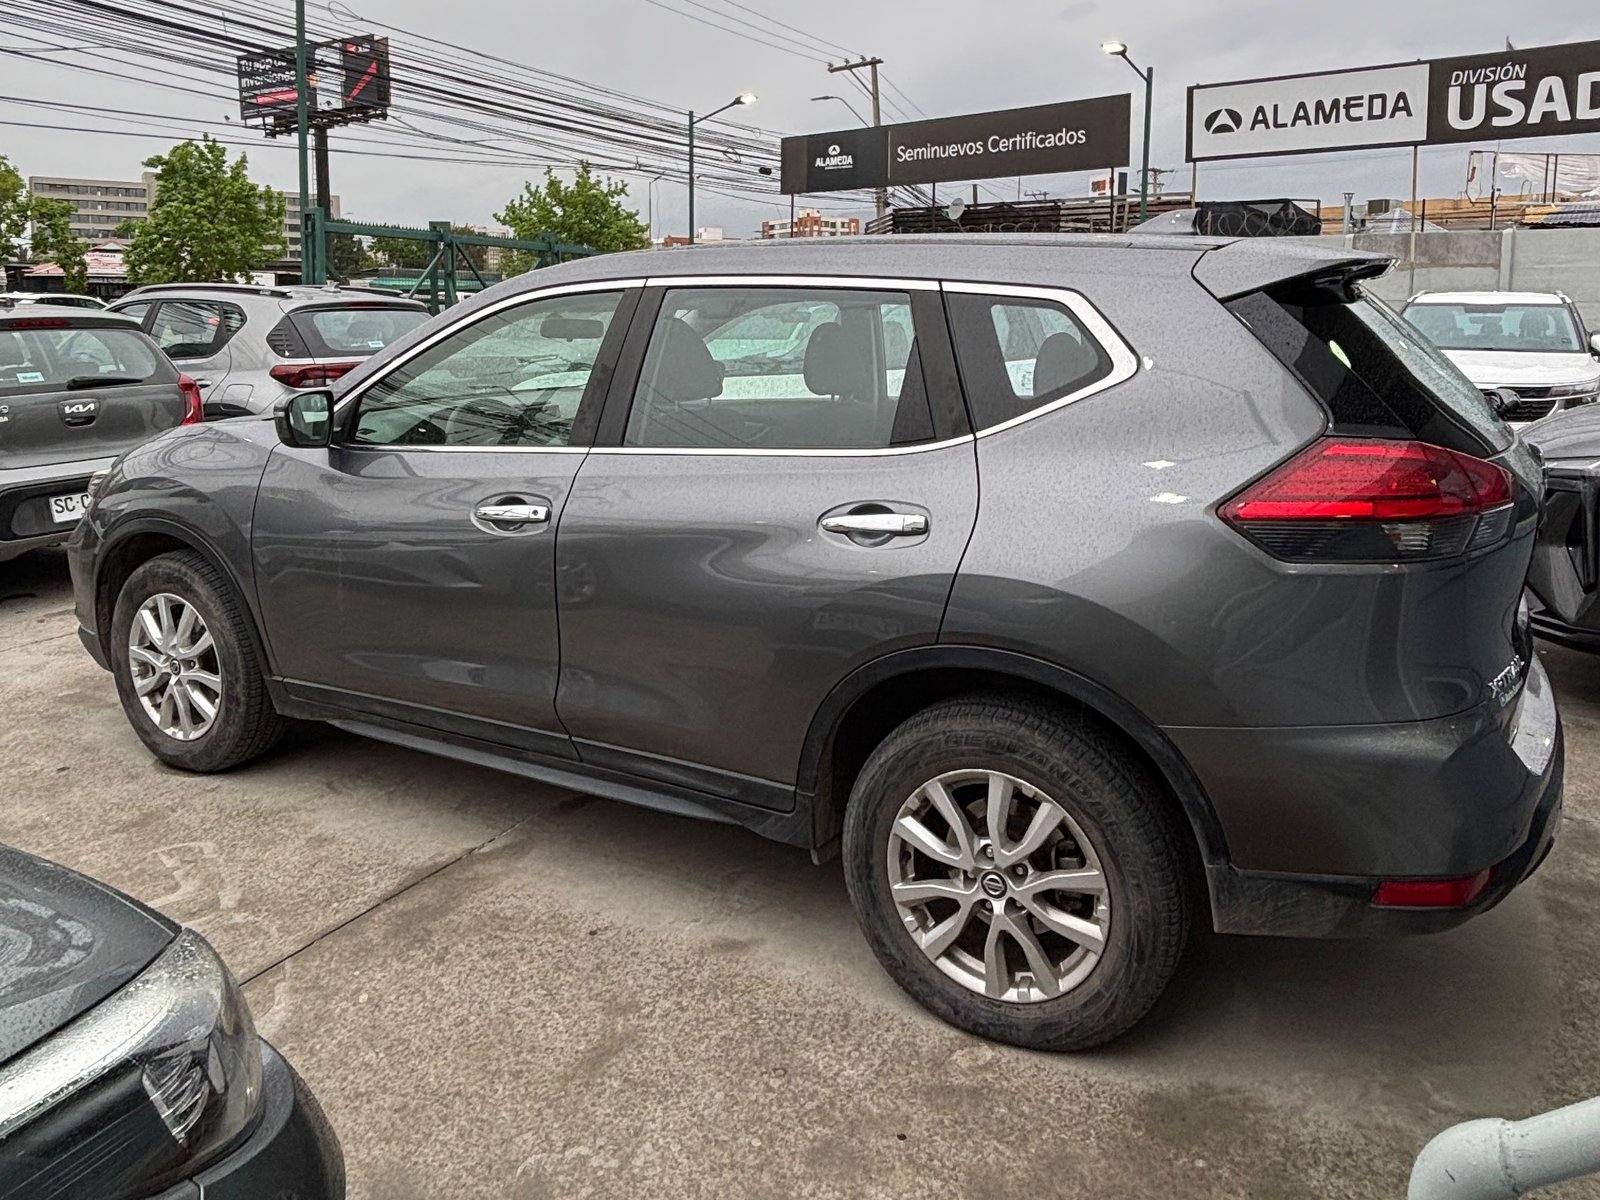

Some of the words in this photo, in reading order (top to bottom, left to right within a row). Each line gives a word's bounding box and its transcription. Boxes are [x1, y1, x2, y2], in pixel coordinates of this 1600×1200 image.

[1450, 61, 1527, 86] DIVISIÓN
[1250, 91, 1413, 131] ALAMEDA
[896, 141, 984, 162] Seminuevos
[987, 127, 1087, 154] Certificados
[815, 155, 853, 168] ALAMEDA
